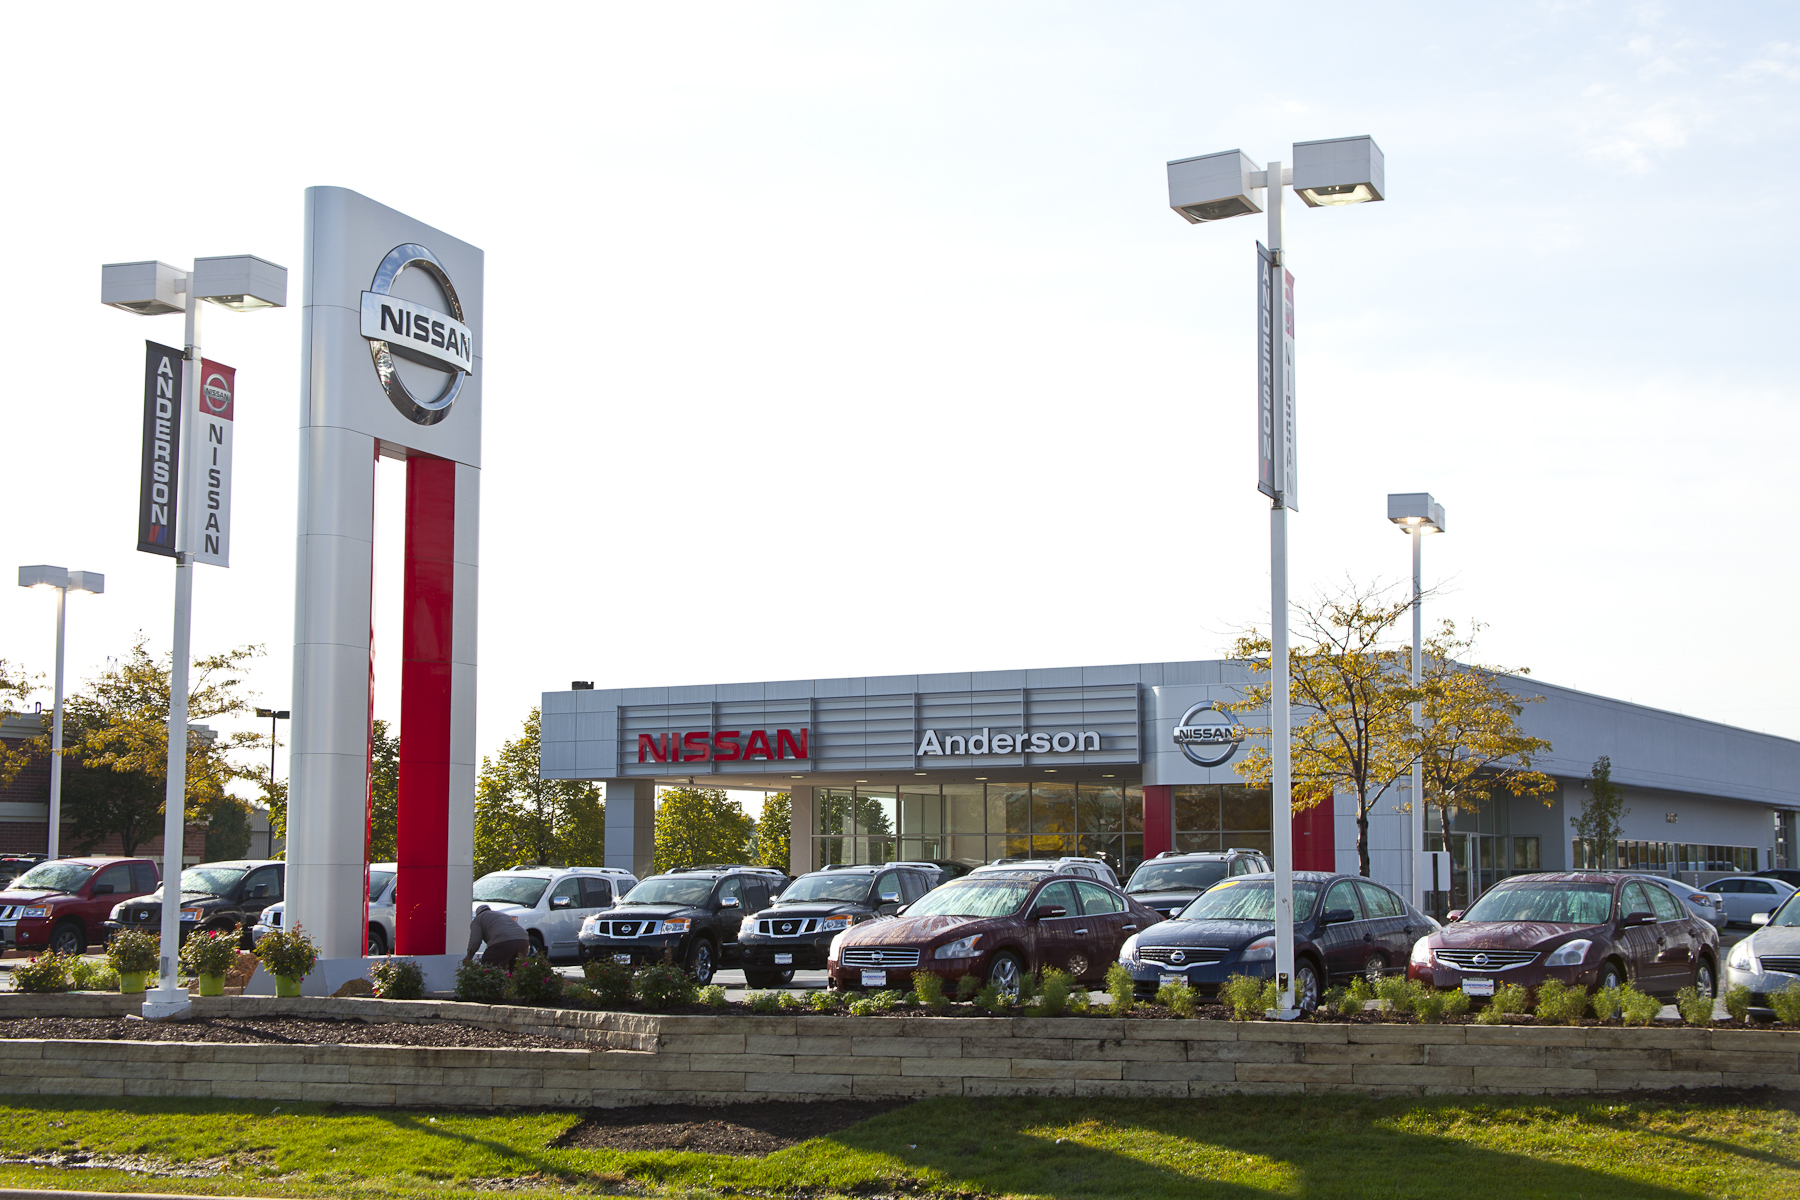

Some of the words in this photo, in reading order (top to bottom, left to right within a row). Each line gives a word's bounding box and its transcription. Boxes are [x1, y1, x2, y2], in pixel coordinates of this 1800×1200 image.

[380, 303, 470, 363] NISSAN
[205, 387, 229, 401] NISSAN
[152, 356, 174, 526] ANDERSON
[204, 423, 223, 555] NISSAN
[638, 728, 808, 764] NISSAN
[917, 727, 1101, 756] Anderson
